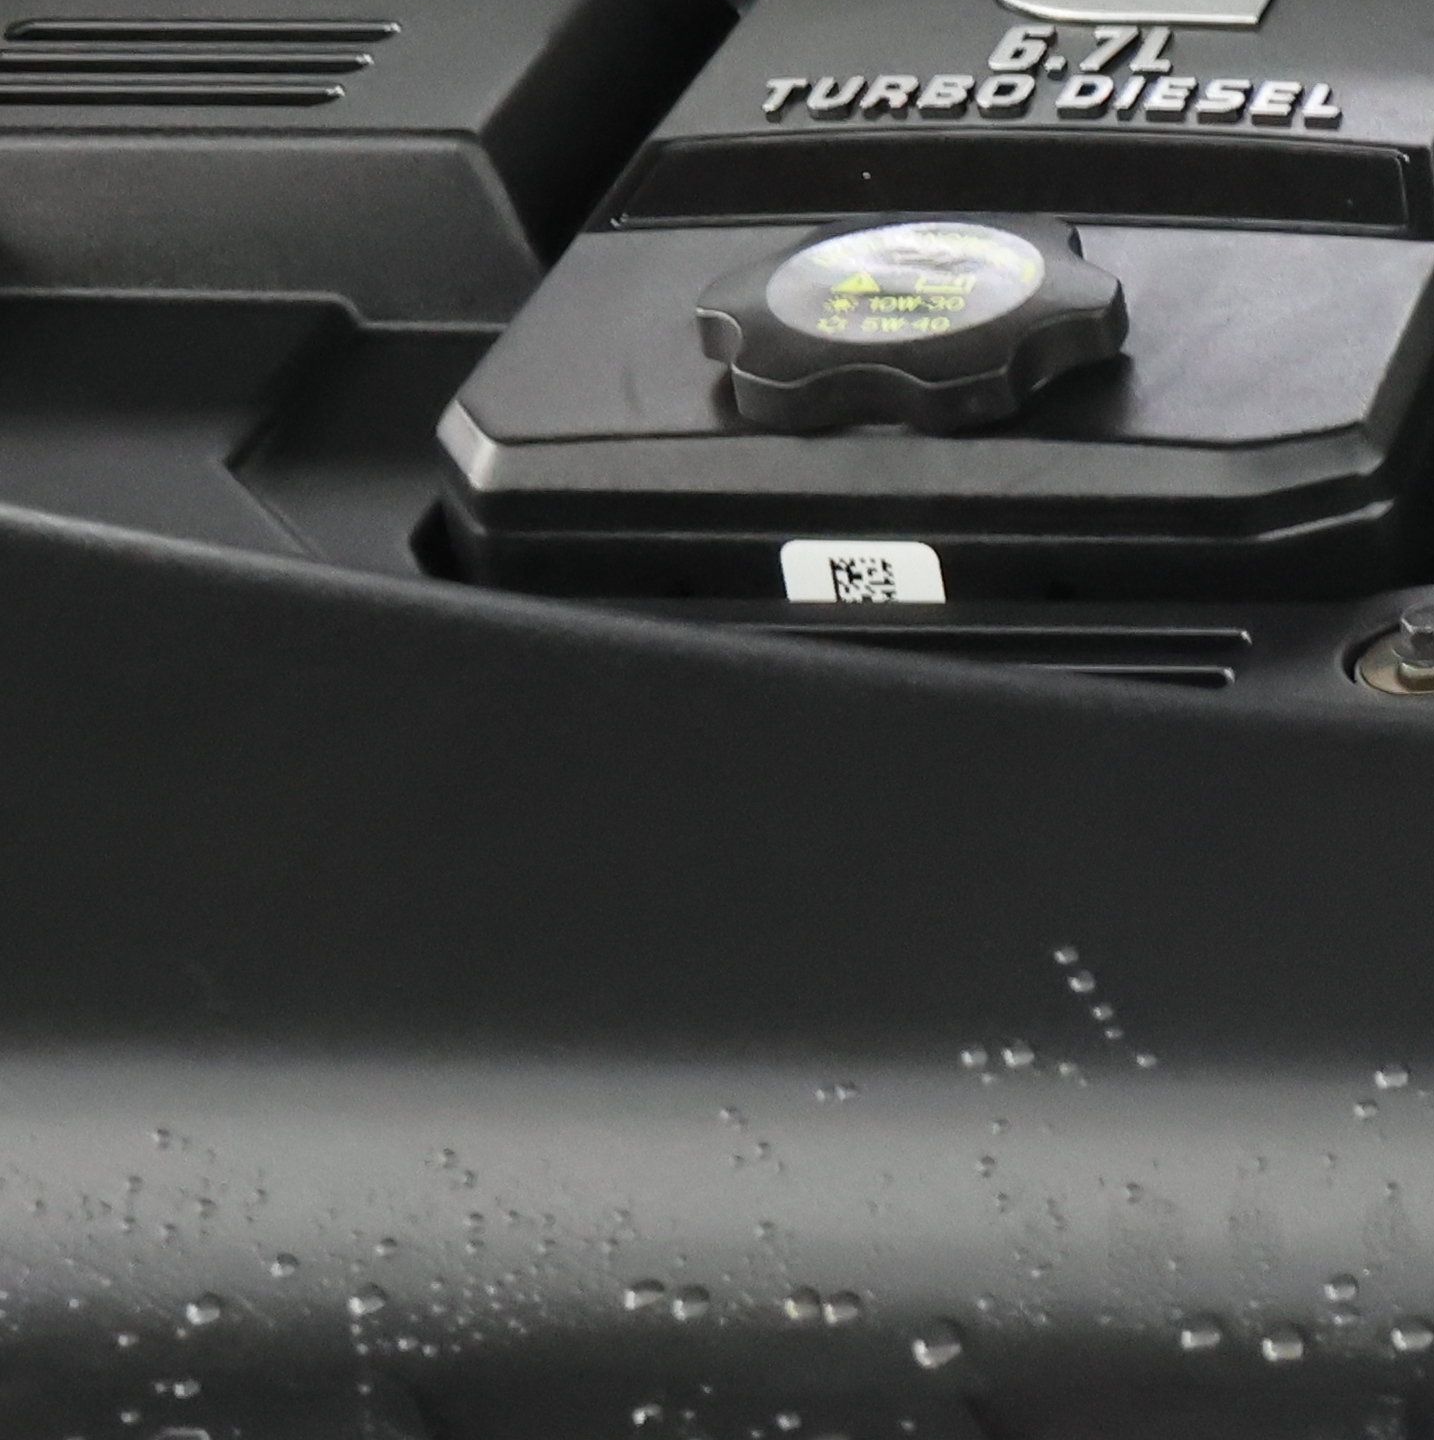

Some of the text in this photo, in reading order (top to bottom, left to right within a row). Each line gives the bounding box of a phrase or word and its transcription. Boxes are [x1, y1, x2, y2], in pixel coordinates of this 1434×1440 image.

[988, 24, 1174, 75] 6.7L
[762, 72, 1343, 126] TURBO DIESEL
[868, 294, 967, 313] 10W-30
